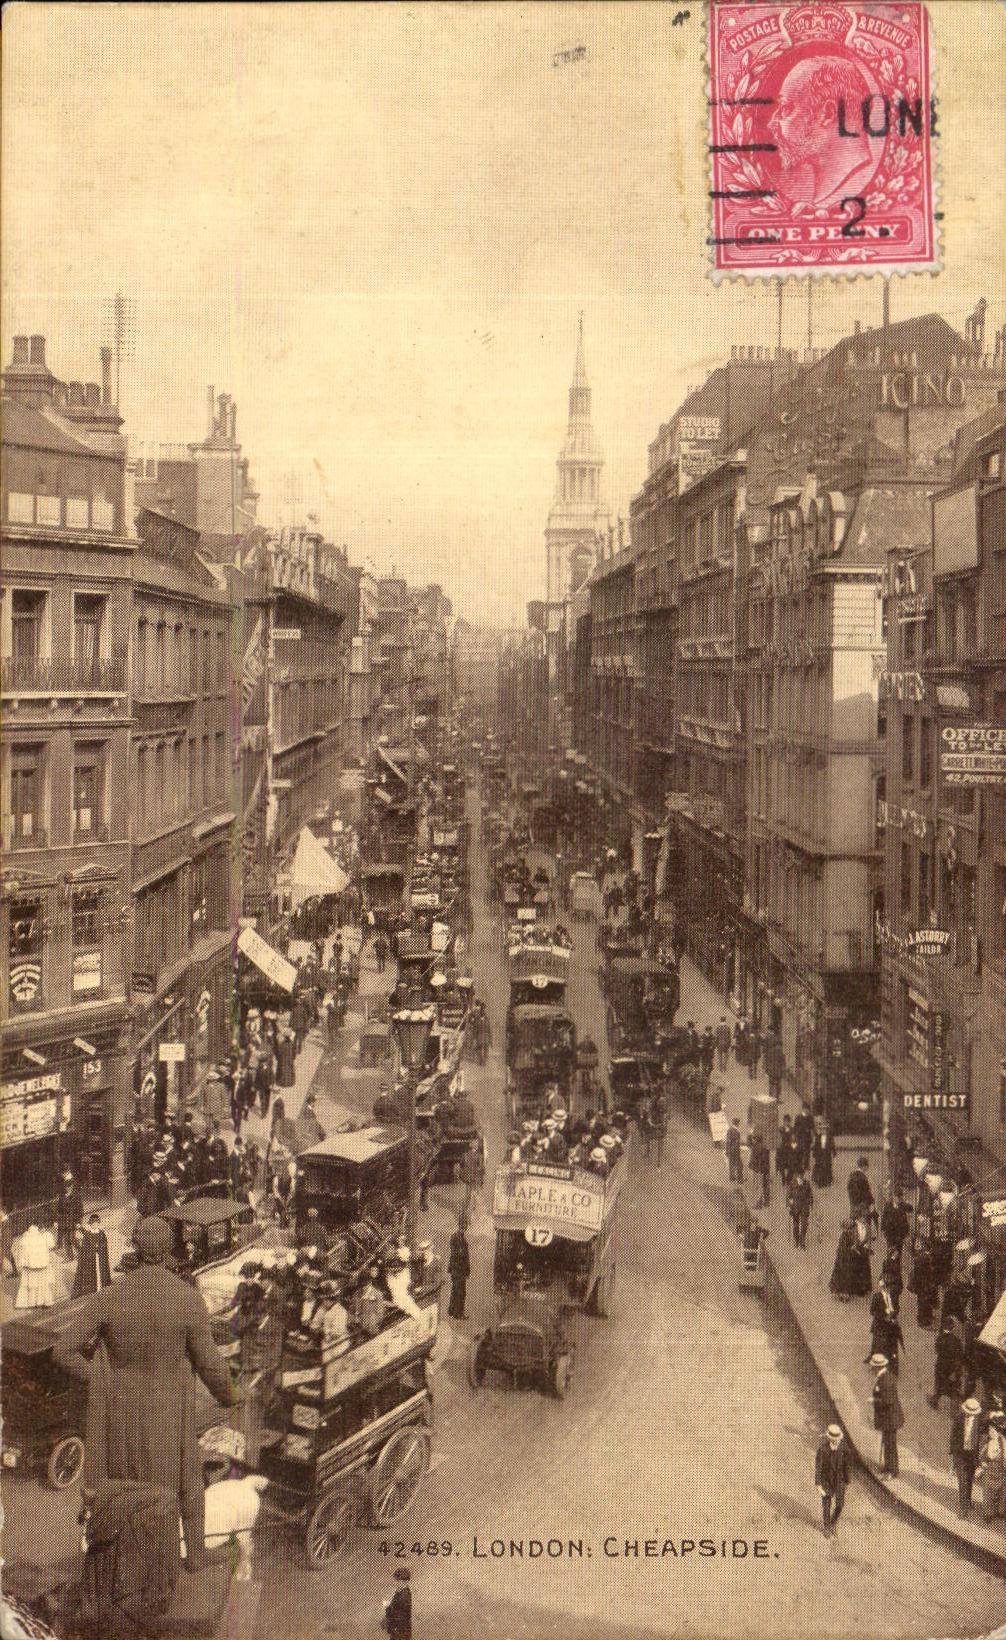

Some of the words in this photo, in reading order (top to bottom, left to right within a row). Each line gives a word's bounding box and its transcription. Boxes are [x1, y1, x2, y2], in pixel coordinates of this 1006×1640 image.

[729, 18, 778, 51] POSTAGE
[748, 226, 803, 242] ONE
[680, 416, 720, 427] STUDIO
[681, 427, 695, 439] TO
[696, 427, 720, 440] LET
[948, 741, 967, 751] TO
[903, 1094, 967, 1108] DENTIST
[571, 1192, 592, 1208] CO
[514, 1200, 577, 1218] FURNITURE
[531, 1229, 550, 1243] 17
